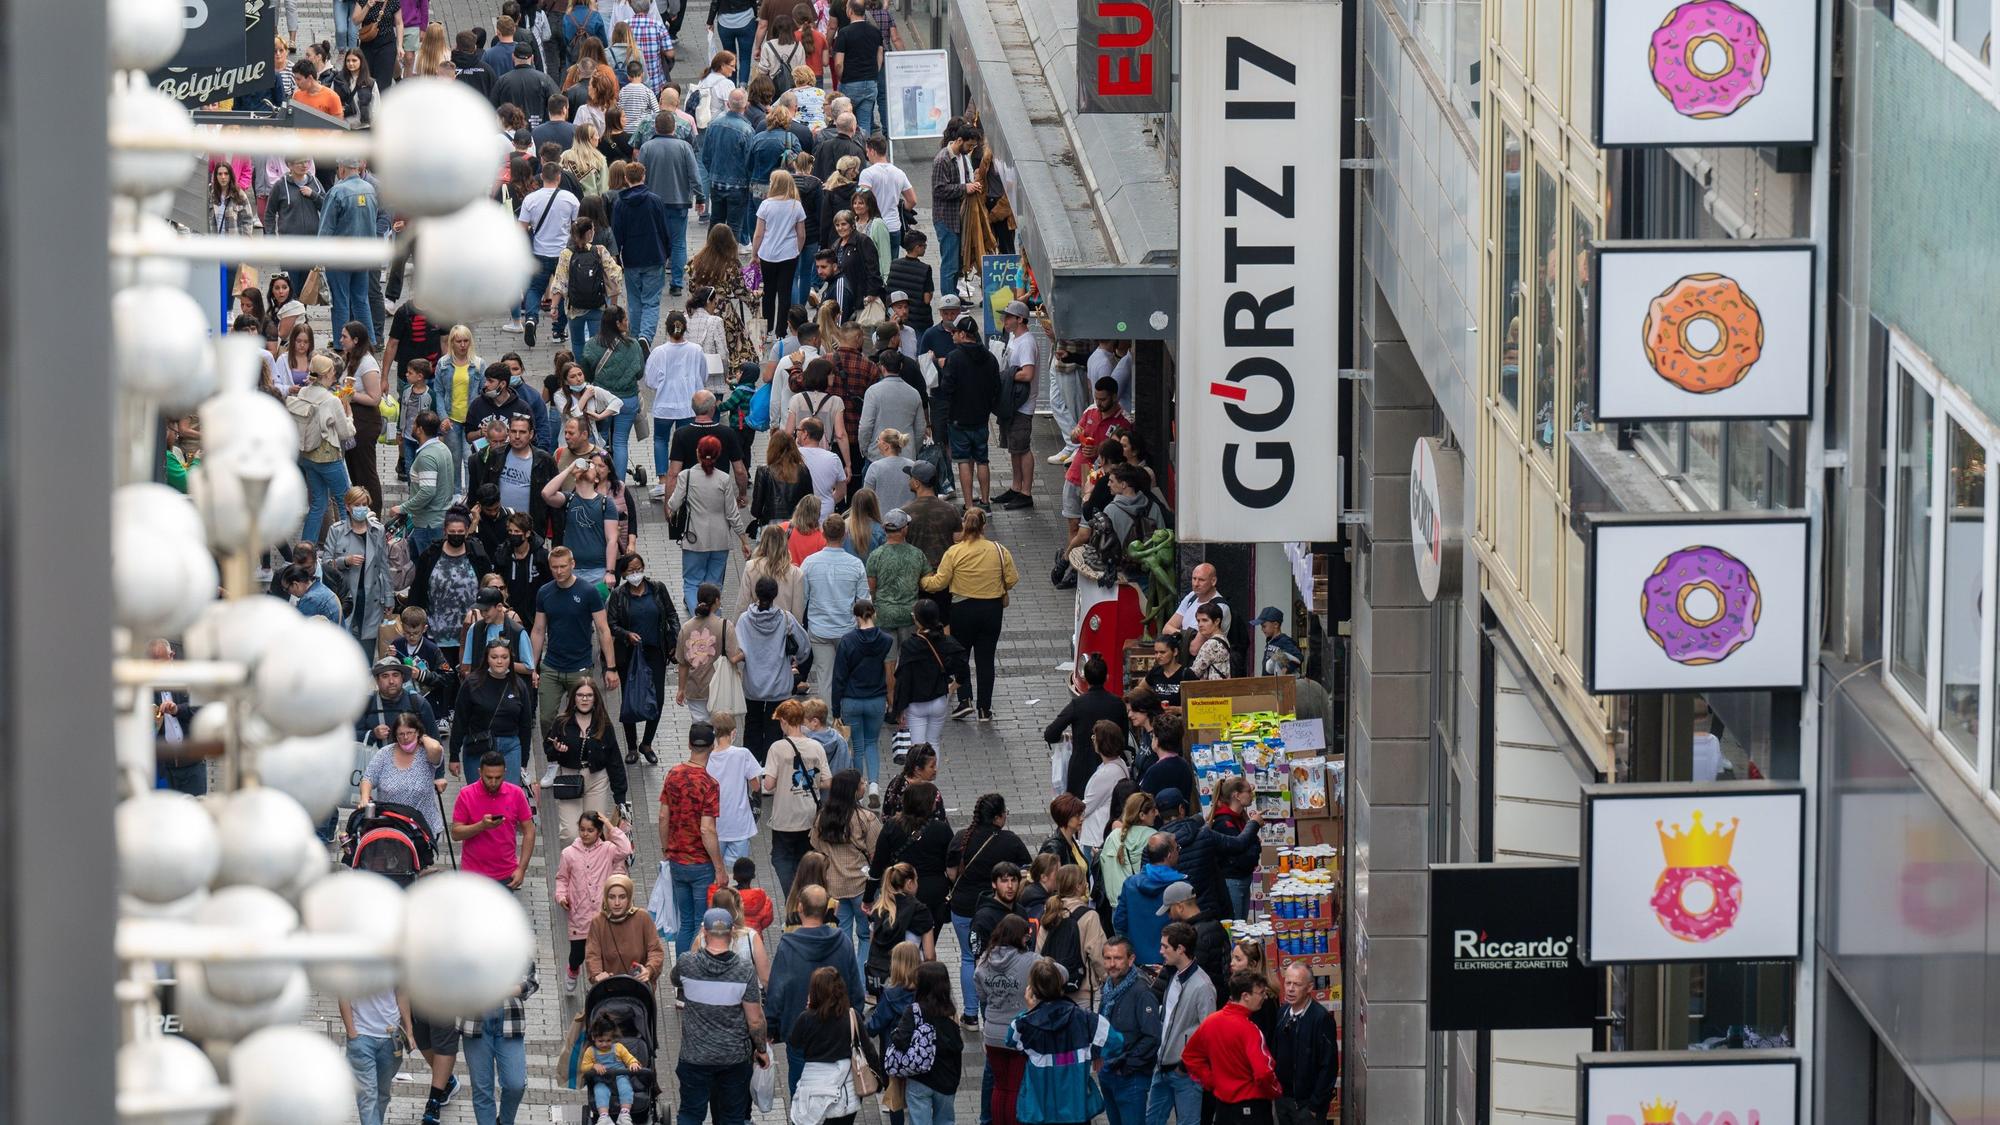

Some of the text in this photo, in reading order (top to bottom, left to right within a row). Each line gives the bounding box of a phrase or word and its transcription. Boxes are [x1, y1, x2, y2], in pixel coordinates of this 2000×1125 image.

[157, 61, 266, 103] Belgique
[1224, 36, 1297, 120] 17
[1454, 928, 1569, 958] Riccardo
[1454, 960, 1568, 970] ELEKTRISCHE ZIGARETTEN
